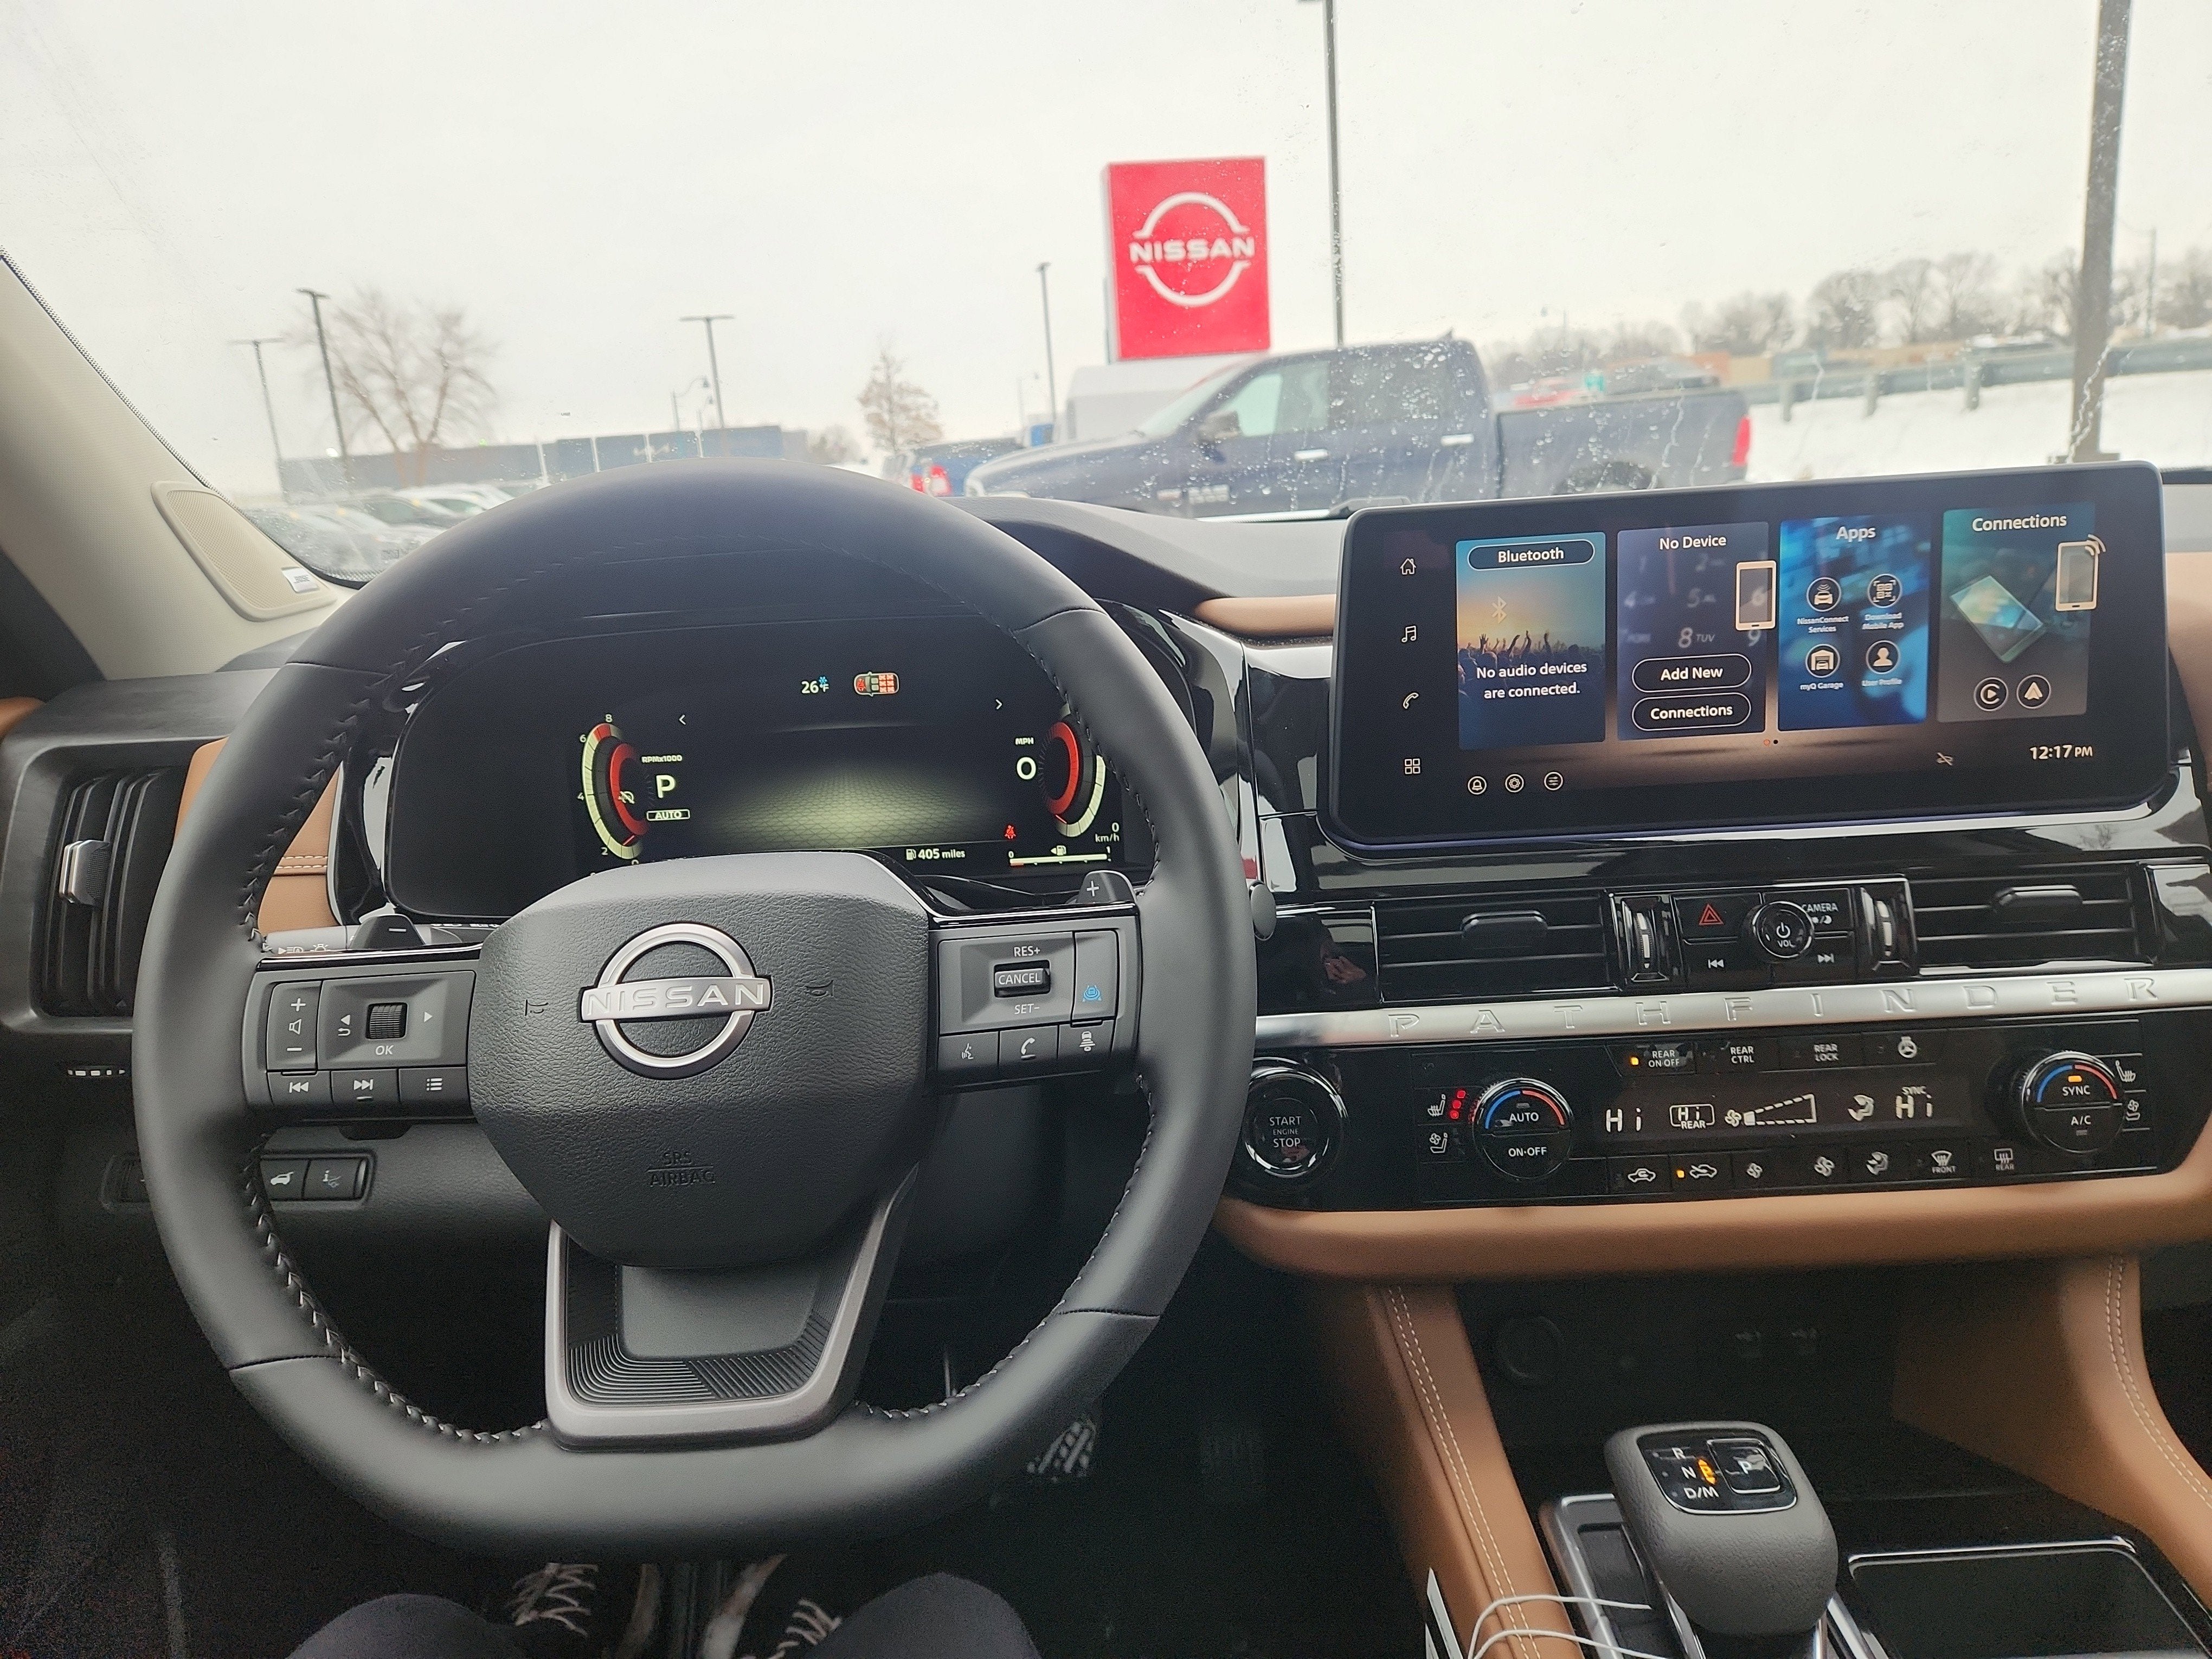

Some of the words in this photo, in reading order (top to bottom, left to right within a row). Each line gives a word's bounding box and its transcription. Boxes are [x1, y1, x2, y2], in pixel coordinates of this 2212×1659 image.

[1128, 237, 1256, 264] NISSAN
[1972, 514, 2067, 532] Connections
[1836, 526, 1876, 542] Apps
[1660, 537, 1679, 550] No
[1683, 535, 1727, 548] Device
[1497, 548, 1564, 564] Bluetooth
[1678, 627, 1693, 648] 8
[1696, 633, 1715, 642] TUV
[1476, 666, 1496, 679] No
[1499, 664, 1536, 677] audio
[1540, 661, 1587, 675] devices
[1661, 667, 1689, 681] Add
[1692, 666, 1724, 679] New
[1484, 688, 1506, 699] are
[1508, 683, 1580, 698] connected.
[1800, 683, 1816, 691] myQ
[1650, 705, 1733, 720] Connections
[606, 714, 613, 723] 8
[579, 734, 587, 743] 6
[1015, 737, 1034, 745] MPH
[2030, 744, 2072, 760] 12:17
[2074, 746, 2093, 758] PM
[642, 754, 683, 763] RPMx1000
[1016, 757, 1037, 780] 0
[656, 774, 677, 799] P
[577, 792, 585, 801] 4
[654, 811, 682, 819] AUTO
[1111, 822, 1120, 832] 0
[1095, 833, 1120, 843] km/h
[601, 846, 608, 856] 2
[918, 849, 940, 860] 405
[941, 848, 966, 859] miles
[1008, 850, 1014, 859] 0
[1802, 902, 1838, 912] CAMERA
[1777, 940, 1795, 948] VOL
[1014, 946, 1041, 957] RES+
[998, 973, 1041, 985] CANCEL
[586, 982, 764, 1016] NISSAN
[1387, 978, 2159, 1038] PATHFINDER
[375, 1045, 395, 1056] OK
[1651, 1049, 1675, 1059] REAR
[1730, 1045, 1754, 1055] REAR
[1814, 1044, 1838, 1053] REAR
[1731, 1054, 1754, 1064] CTRL
[1815, 1052, 1839, 1062] LOCK
[1901, 1086, 1926, 1095] SYNC
[2062, 1085, 2091, 1096] SYNC
[1895, 1094, 1932, 1120] Hi
[1509, 1112, 1539, 1122] AUTO
[1677, 1107, 1700, 1121] Hi
[1269, 1116, 1302, 1126] START
[1606, 1108, 1642, 1132] Hi
[1681, 1120, 1706, 1130] REAR
[2070, 1115, 2092, 1126] A/C
[1273, 1137, 1301, 1148] STOP
[662, 1151, 693, 1166] SRS
[1931, 1166, 1956, 1174] FRONT
[650, 1169, 716, 1188] AIRBAG
[1672, 1447, 1686, 1460] R
[1681, 1466, 1697, 1479] N
[1738, 1460, 1752, 1474] P
[1683, 1486, 1720, 1499] D/M
